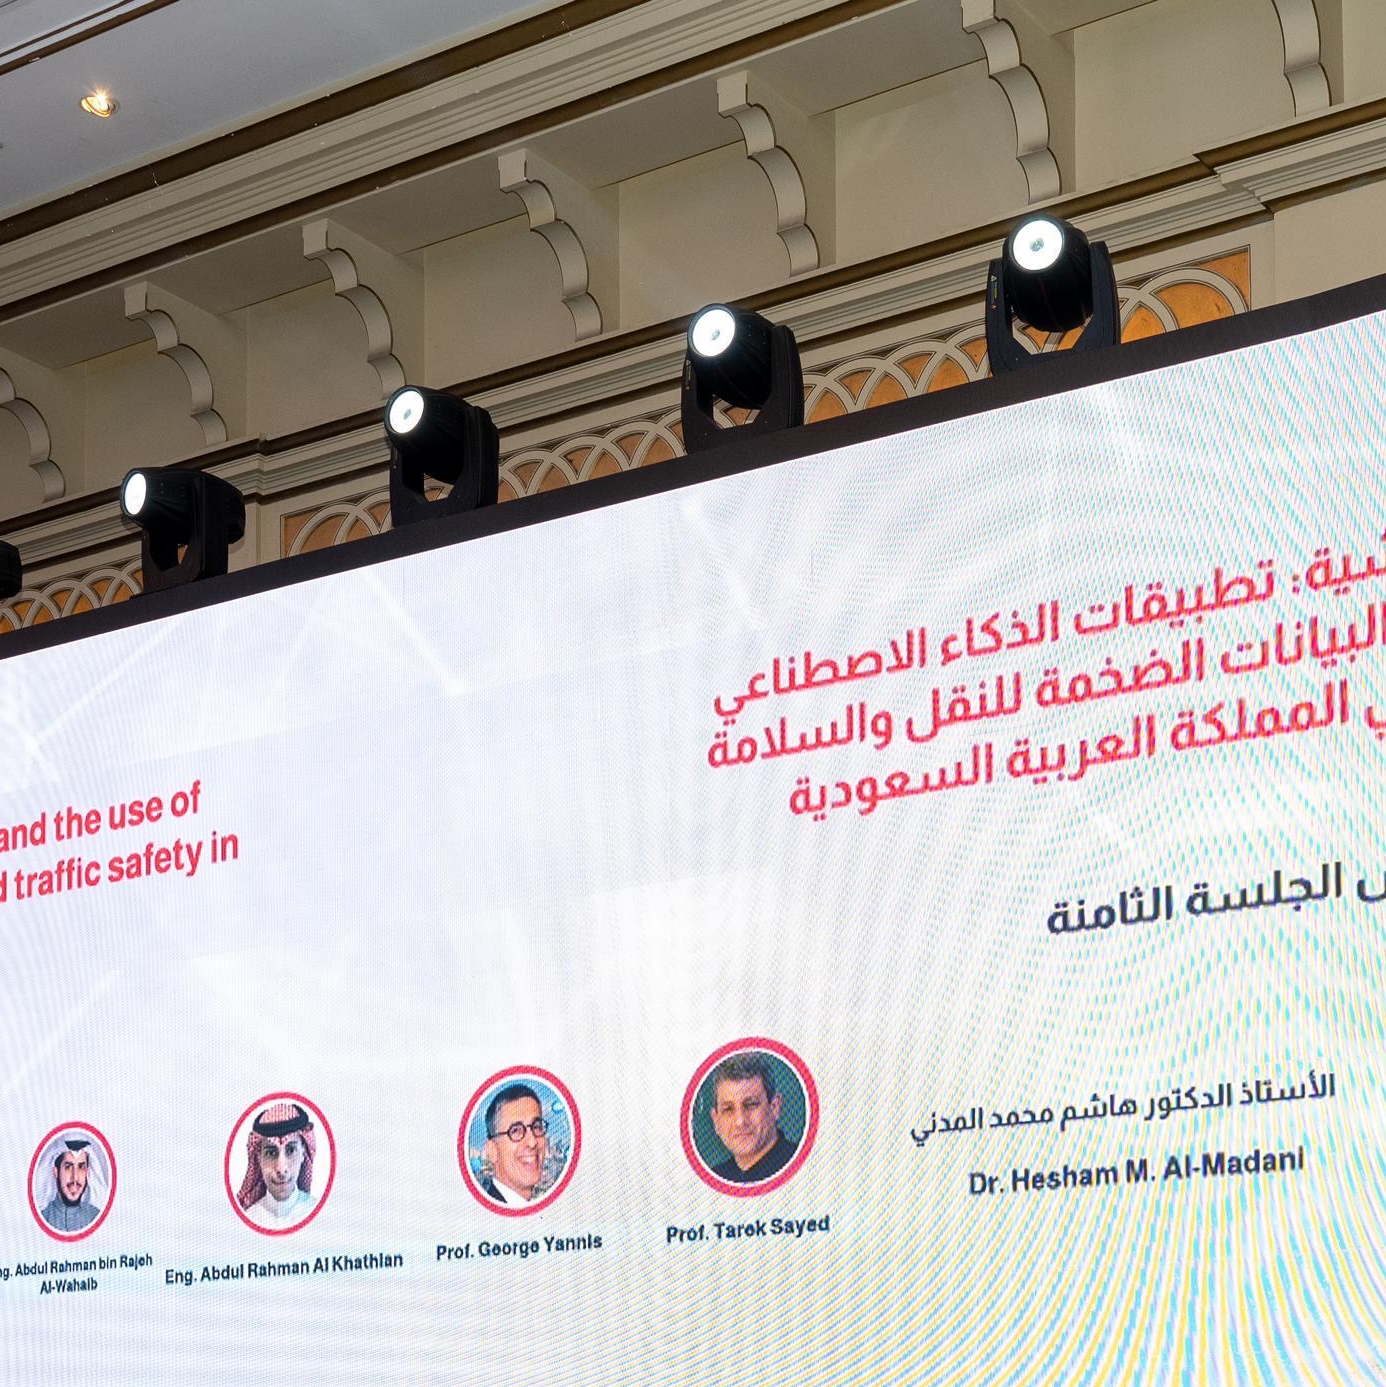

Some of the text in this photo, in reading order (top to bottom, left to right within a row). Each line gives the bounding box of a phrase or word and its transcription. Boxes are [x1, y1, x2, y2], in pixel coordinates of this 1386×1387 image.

[1074, 558, 1275, 636] تطبيقات
[940, 600, 1059, 667] الذكاء
[713, 626, 927, 727] الاصطناعي
[1035, 638, 1204, 708] الضخمة
[707, 701, 893, 768] والسلامة
[906, 672, 1021, 744] للنقل
[1170, 678, 1348, 751] المملكة
[789, 742, 993, 821] السعودية
[1006, 714, 1155, 784] العربية
[54, 806, 102, 841] the
[109, 796, 163, 831] use
[170, 779, 201, 817] of
[14, 857, 101, 901] traffic
[108, 840, 203, 883] safety
[211, 830, 239, 864] in
[1186, 860, 1342, 916] الجلسة
[1047, 884, 1174, 935] الثامنة
[911, 1069, 1336, 1147] الأستاذ الدكتور هاشم محمد المدني
[969, 1145, 1305, 1196] Dr. Hesham M. Al-Madani
[436, 1232, 603, 1261] Prof. George Yannis
[666, 1214, 831, 1244] Prof. Tarek Sayed
[15, 1261, 48, 1277] Abdul
[50, 1258, 97, 1275] Rahman
[99, 1256, 117, 1271] bin
[165, 1268, 198, 1286] Eng.
[200, 1264, 244, 1282] Abdul
[247, 1260, 309, 1279] Rahman
[312, 1257, 329, 1274] Al
